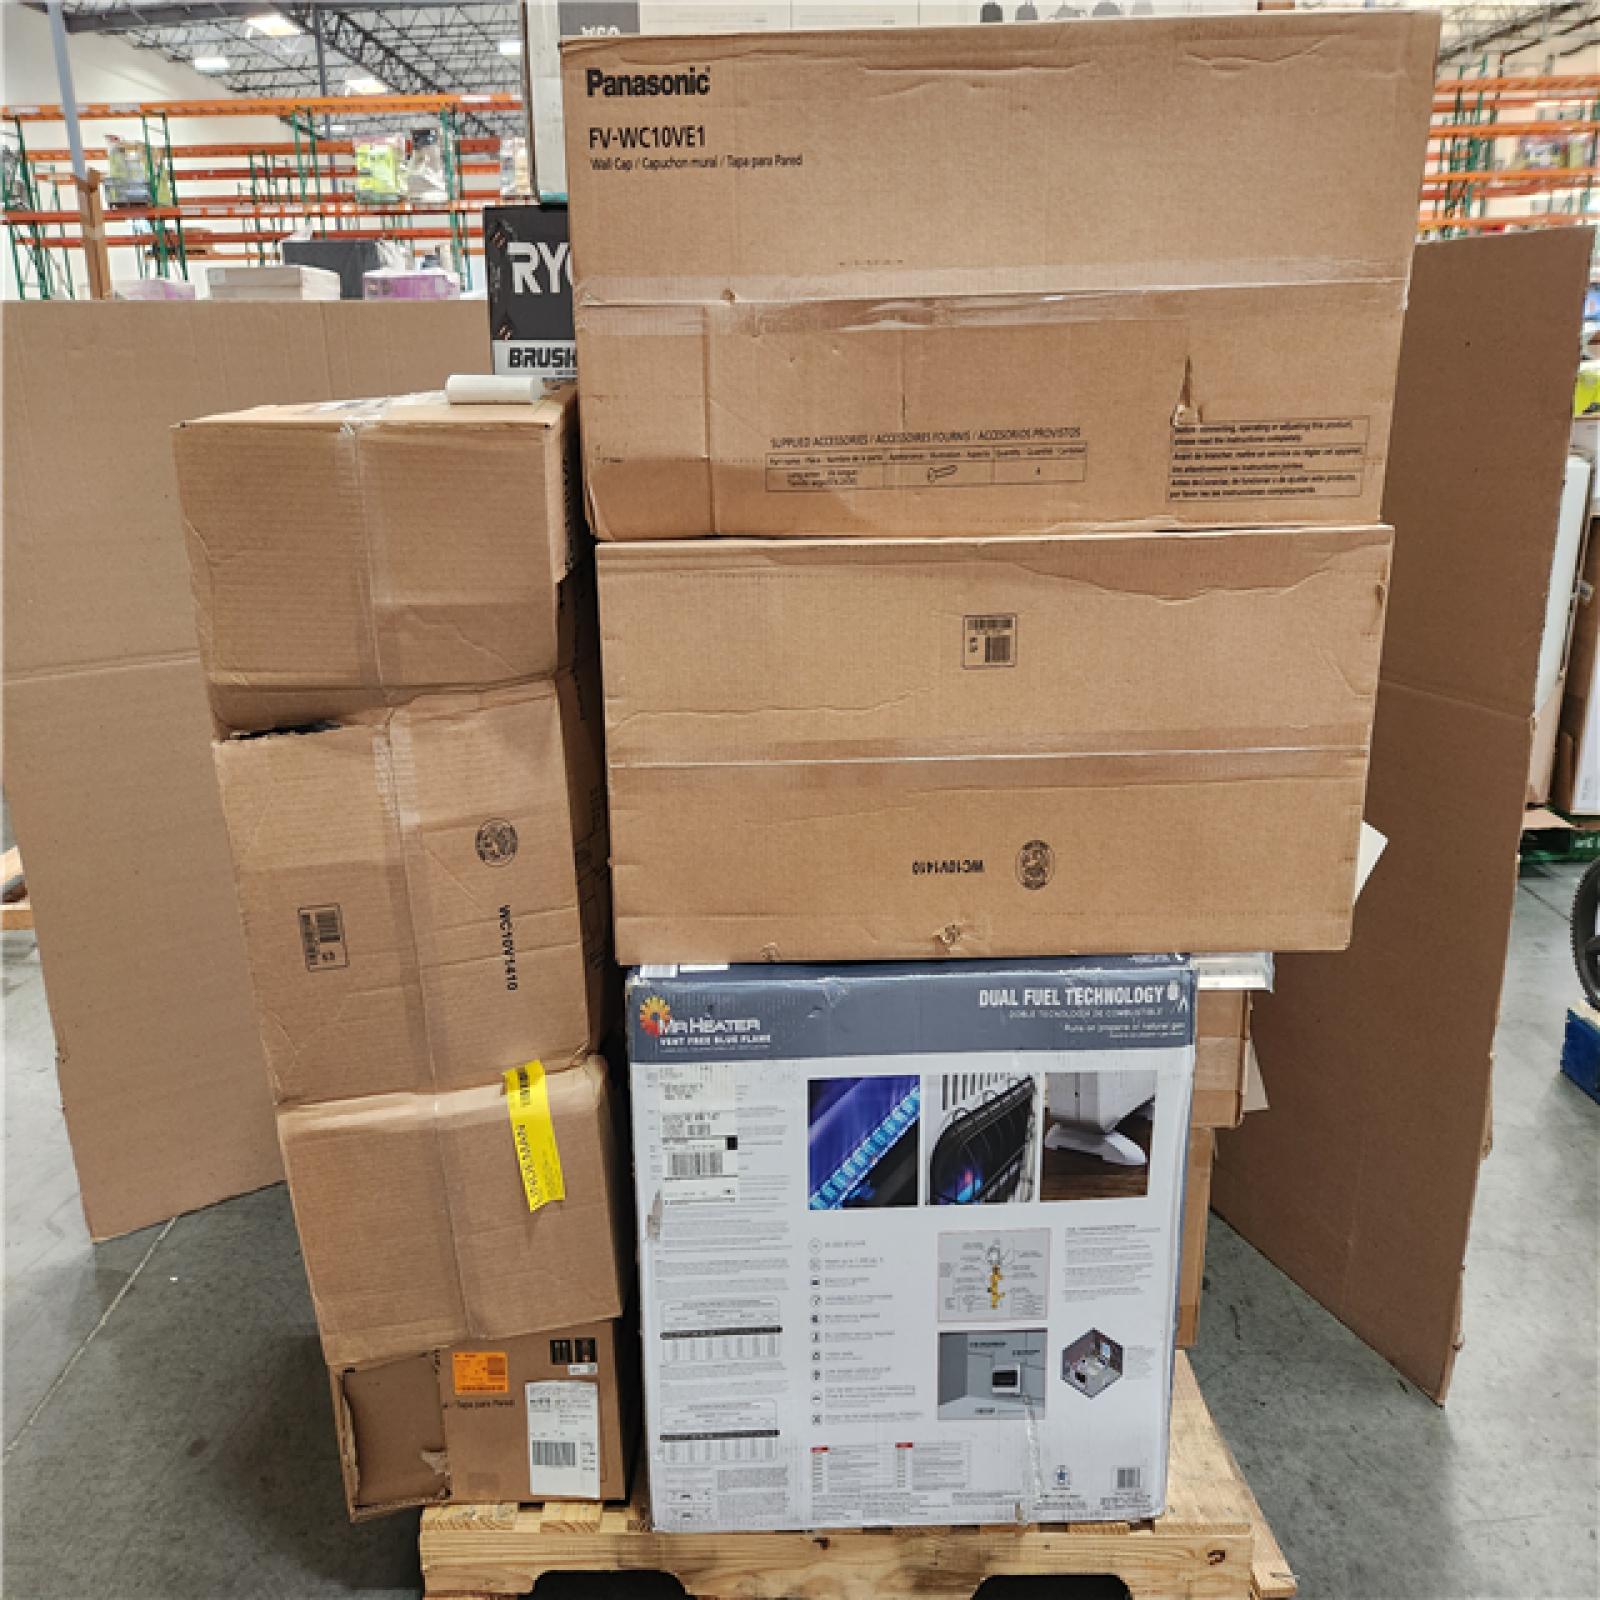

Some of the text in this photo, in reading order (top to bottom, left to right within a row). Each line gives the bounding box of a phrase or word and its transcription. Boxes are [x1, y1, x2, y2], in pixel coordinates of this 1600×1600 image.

[585, 65, 711, 97] Panasonic
[589, 125, 706, 149] FV-WC10VE1
[590, 156, 612, 170] Wall
[615, 156, 633, 172] Cap
[642, 156, 689, 171] Capuchon
[691, 155, 717, 169] mural
[727, 154, 748, 170] Tapa
[751, 155, 774, 170] para
[775, 153, 803, 167] Pared
[770, 436, 810, 448] SUPPLIED
[979, 985, 1165, 1007] DUAL FUEL TECHNOLOGY
